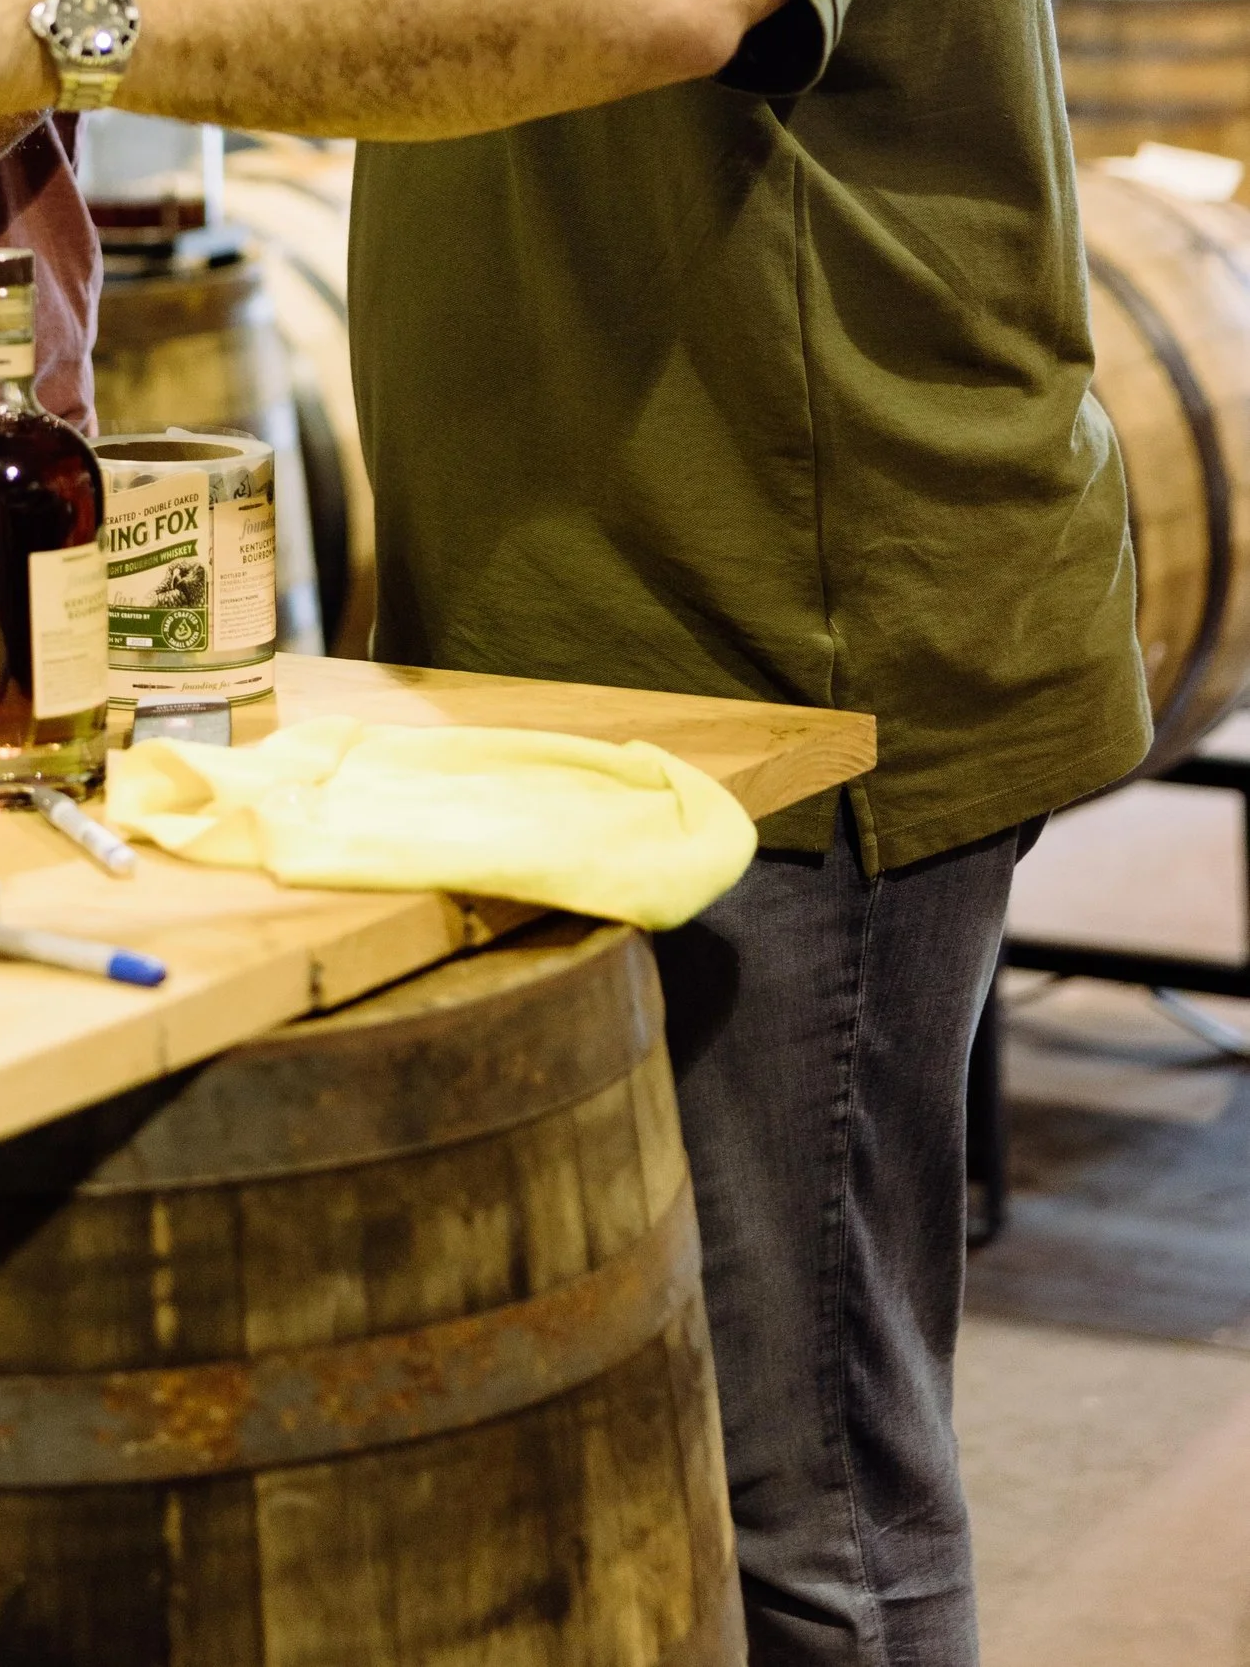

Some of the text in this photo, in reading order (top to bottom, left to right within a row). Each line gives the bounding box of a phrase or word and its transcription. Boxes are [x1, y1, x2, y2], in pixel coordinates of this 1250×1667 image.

[143, 499, 172, 517] DOUBLE
[173, 493, 200, 507] OAKED
[155, 506, 199, 540] FOX
[159, 543, 193, 563] WHISKEY
[174, 611, 199, 625] CRAFTED
[168, 631, 200, 648] SMALL BATCH
[181, 682, 218, 691] founding
